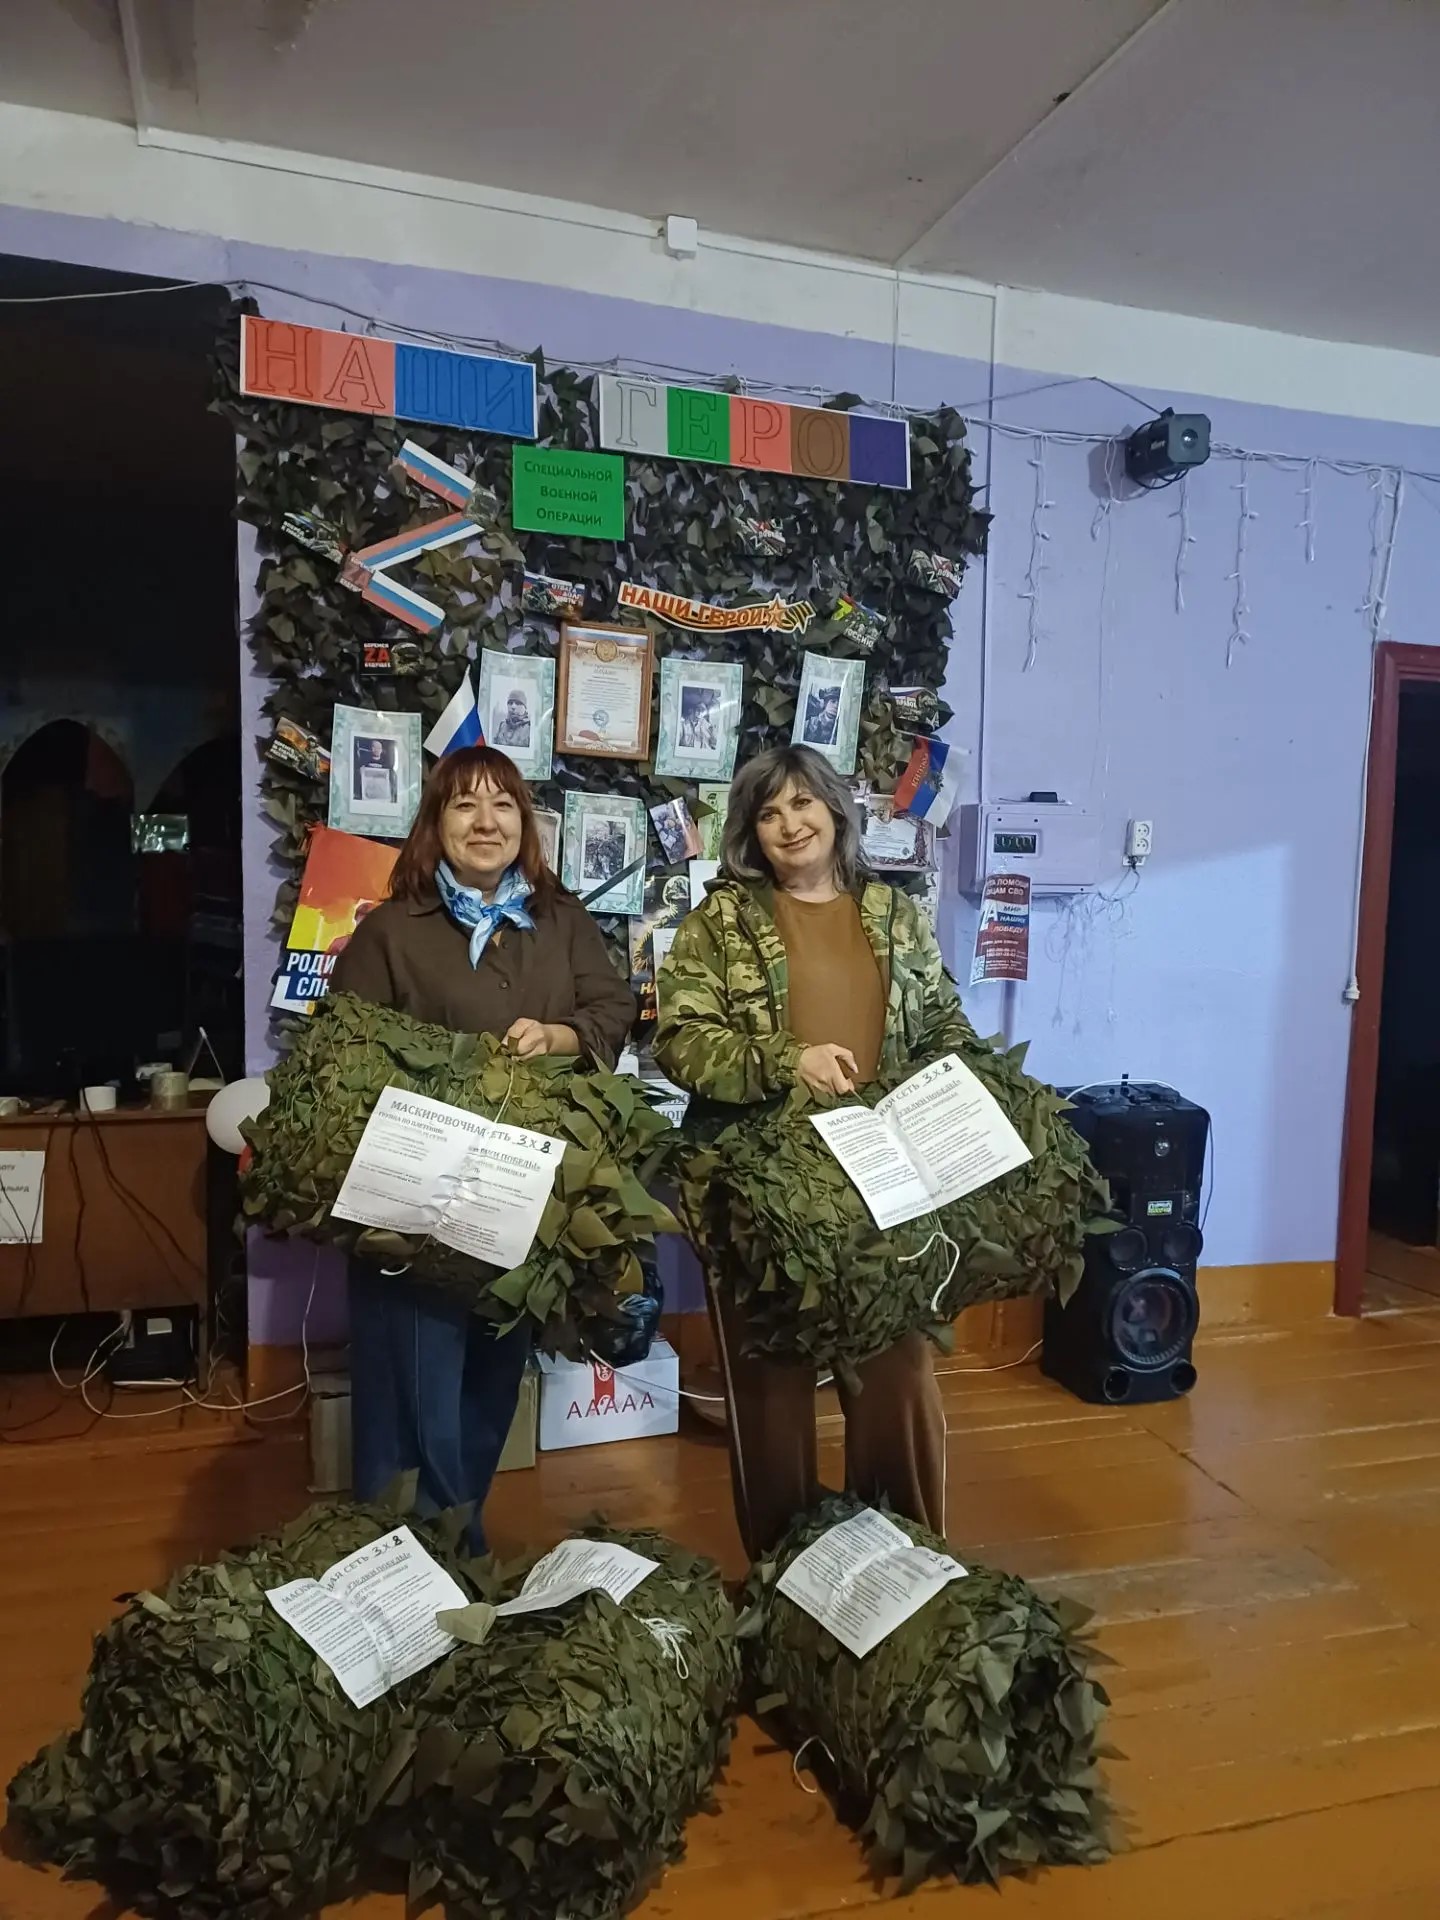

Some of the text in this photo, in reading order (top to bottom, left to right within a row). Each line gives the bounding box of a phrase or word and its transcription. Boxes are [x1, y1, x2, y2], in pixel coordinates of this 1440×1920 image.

[249, 318, 531, 434] НАШИ
[524, 460, 613, 482] СПЕЦИАЛЬНОЙ
[540, 485, 598, 503] ВОЕННОЙ
[536, 507, 602, 526] ОПЕРАЦИИ
[621, 584, 692, 620] НАШИ
[364, 649, 391, 662] ZA
[896, 1083, 920, 1100] СЕТЬ
[922, 1073, 932, 1085] 3
[942, 1062, 953, 1073] 8
[517, 1134, 527, 1146] 3
[540, 1141, 552, 1154] 8
[343, 1556, 369, 1573] СЕТЬ
[372, 1546, 382, 1558] 3
[392, 1535, 403, 1546] 8
